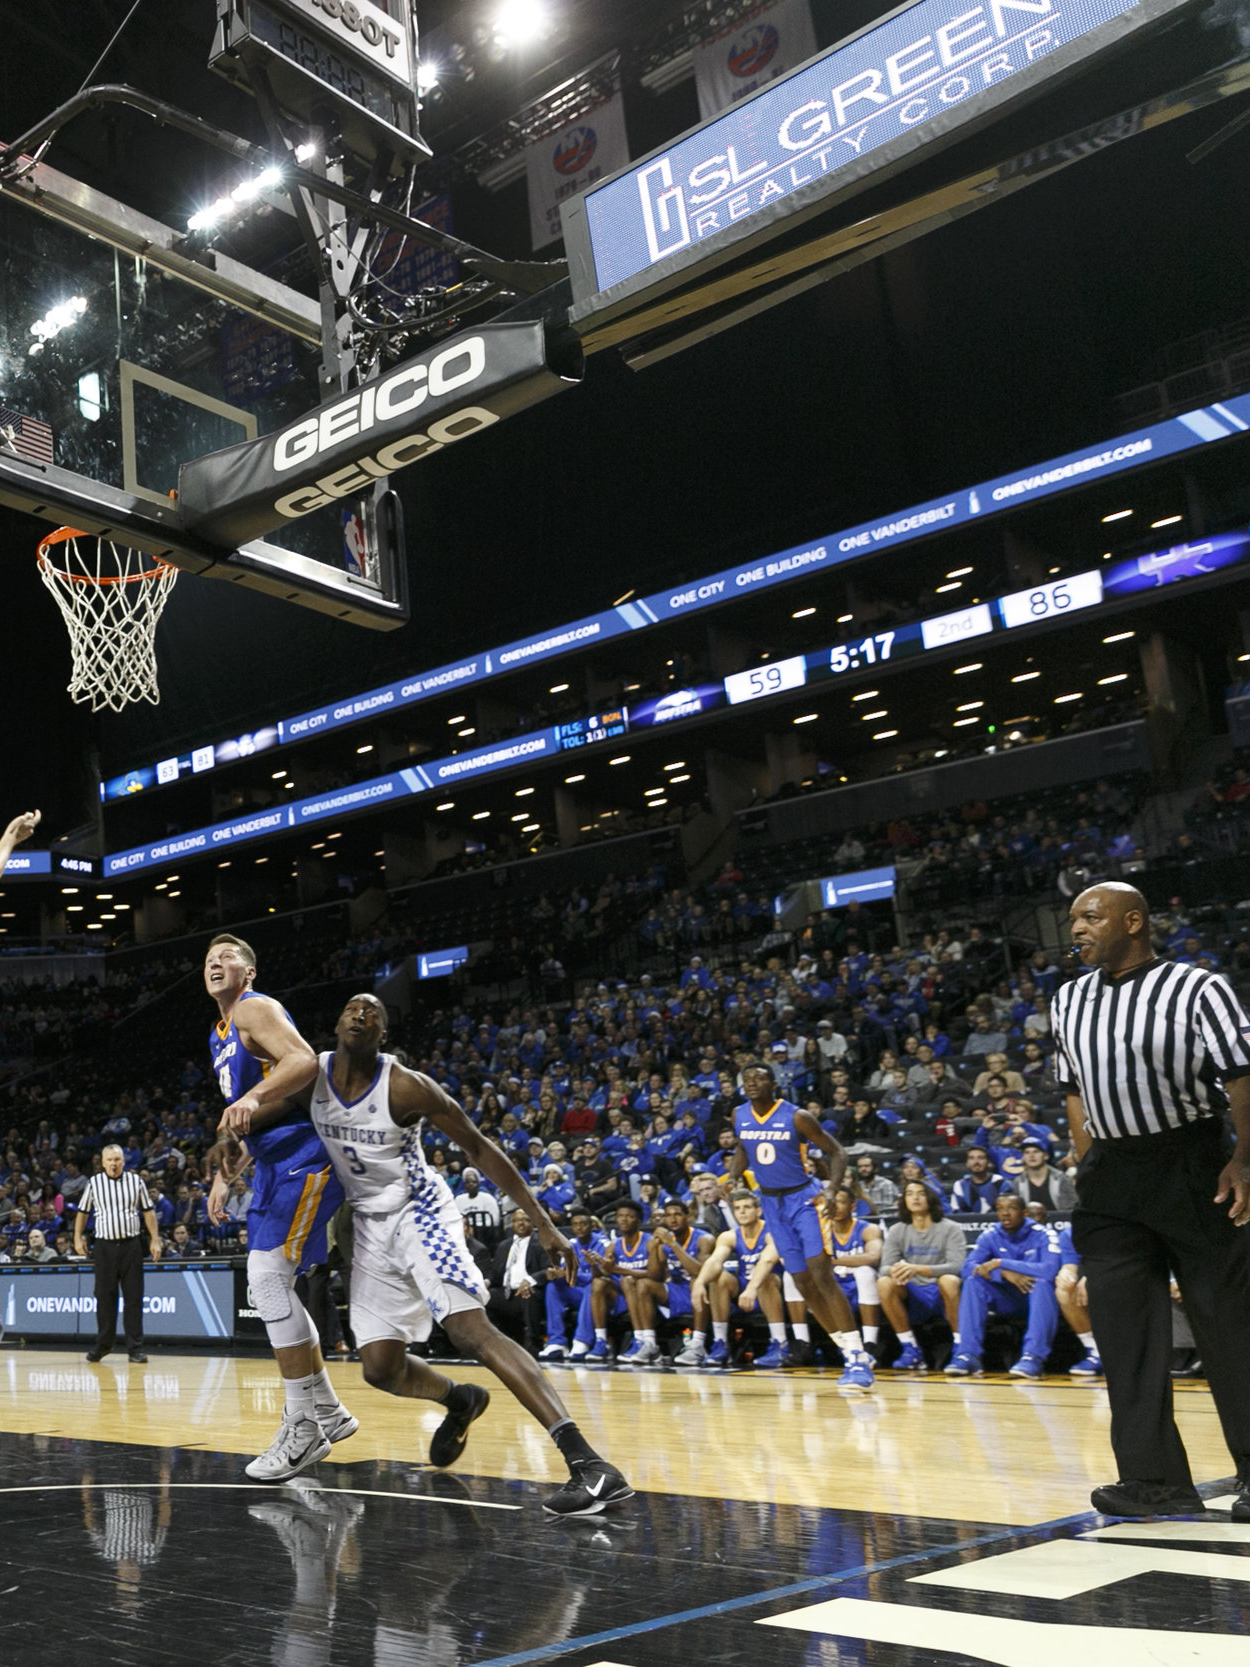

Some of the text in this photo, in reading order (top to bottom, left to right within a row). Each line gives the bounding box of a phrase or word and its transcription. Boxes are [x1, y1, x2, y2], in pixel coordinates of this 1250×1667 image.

[689, 145, 768, 206] SL
[777, 0, 1051, 151] GREEN
[696, 30, 1060, 237] REALTY CORP.
[273, 336, 486, 472] GEICO
[274, 406, 500, 518] GEICO
[669, 438, 1152, 608] ONE CITY ONE BUILDING ONE VANDERBILT ONEVANDERBILT.COM
[289, 623, 600, 734] ONE CITY ONE BUILDING ONE VANDERBILT ONEVANDERBILT.COM
[749, 584, 1072, 695] 59 5:17 2nd 86
[110, 738, 546, 870] ONE CITY ONE BUILDING ONE VANDERBILT ONEVANDERBILT.COM ONEVANDERBILT.COM
[342, 1146, 366, 1175] 3
[739, 1130, 791, 1141] HOFSTRA
[756, 1142, 776, 1165] 0
[238, 1308, 262, 1317] HON
